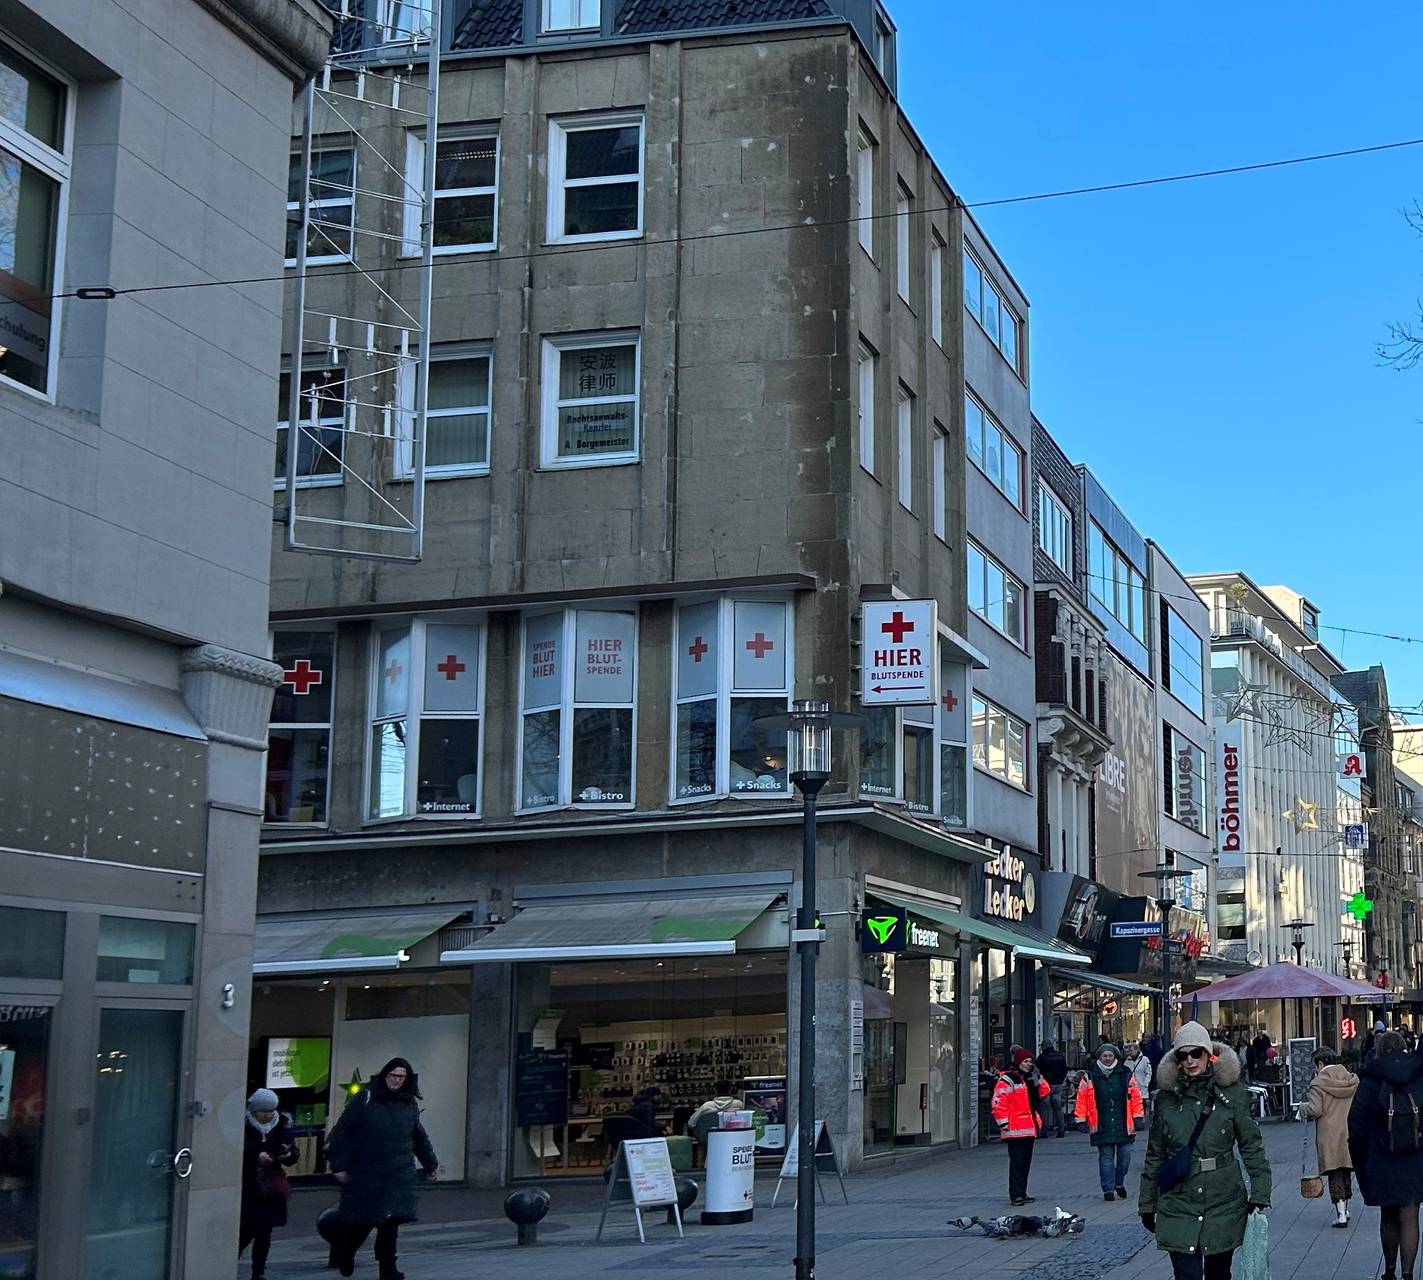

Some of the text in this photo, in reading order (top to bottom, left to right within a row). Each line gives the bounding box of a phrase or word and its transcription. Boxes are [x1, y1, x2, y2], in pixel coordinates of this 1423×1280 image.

[578, 373, 617, 393] 律师
[587, 638, 623, 652] HIER
[532, 650, 556, 665] BLUT
[587, 653, 623, 665] BLUT-
[874, 648, 922, 667] HIER
[531, 662, 556, 679] HIER
[586, 665, 623, 675] SPENDE
[871, 670, 925, 680] BLUTSPENDE
[746, 780, 782, 790] Snacks
[867, 783, 893, 794] Internet
[590, 790, 624, 801] Bistro
[1220, 742, 1241, 852] böhmer
[432, 802, 471, 812] Internet
[983, 878, 1026, 922] Lecker
[223, 983, 234, 1008] 3
